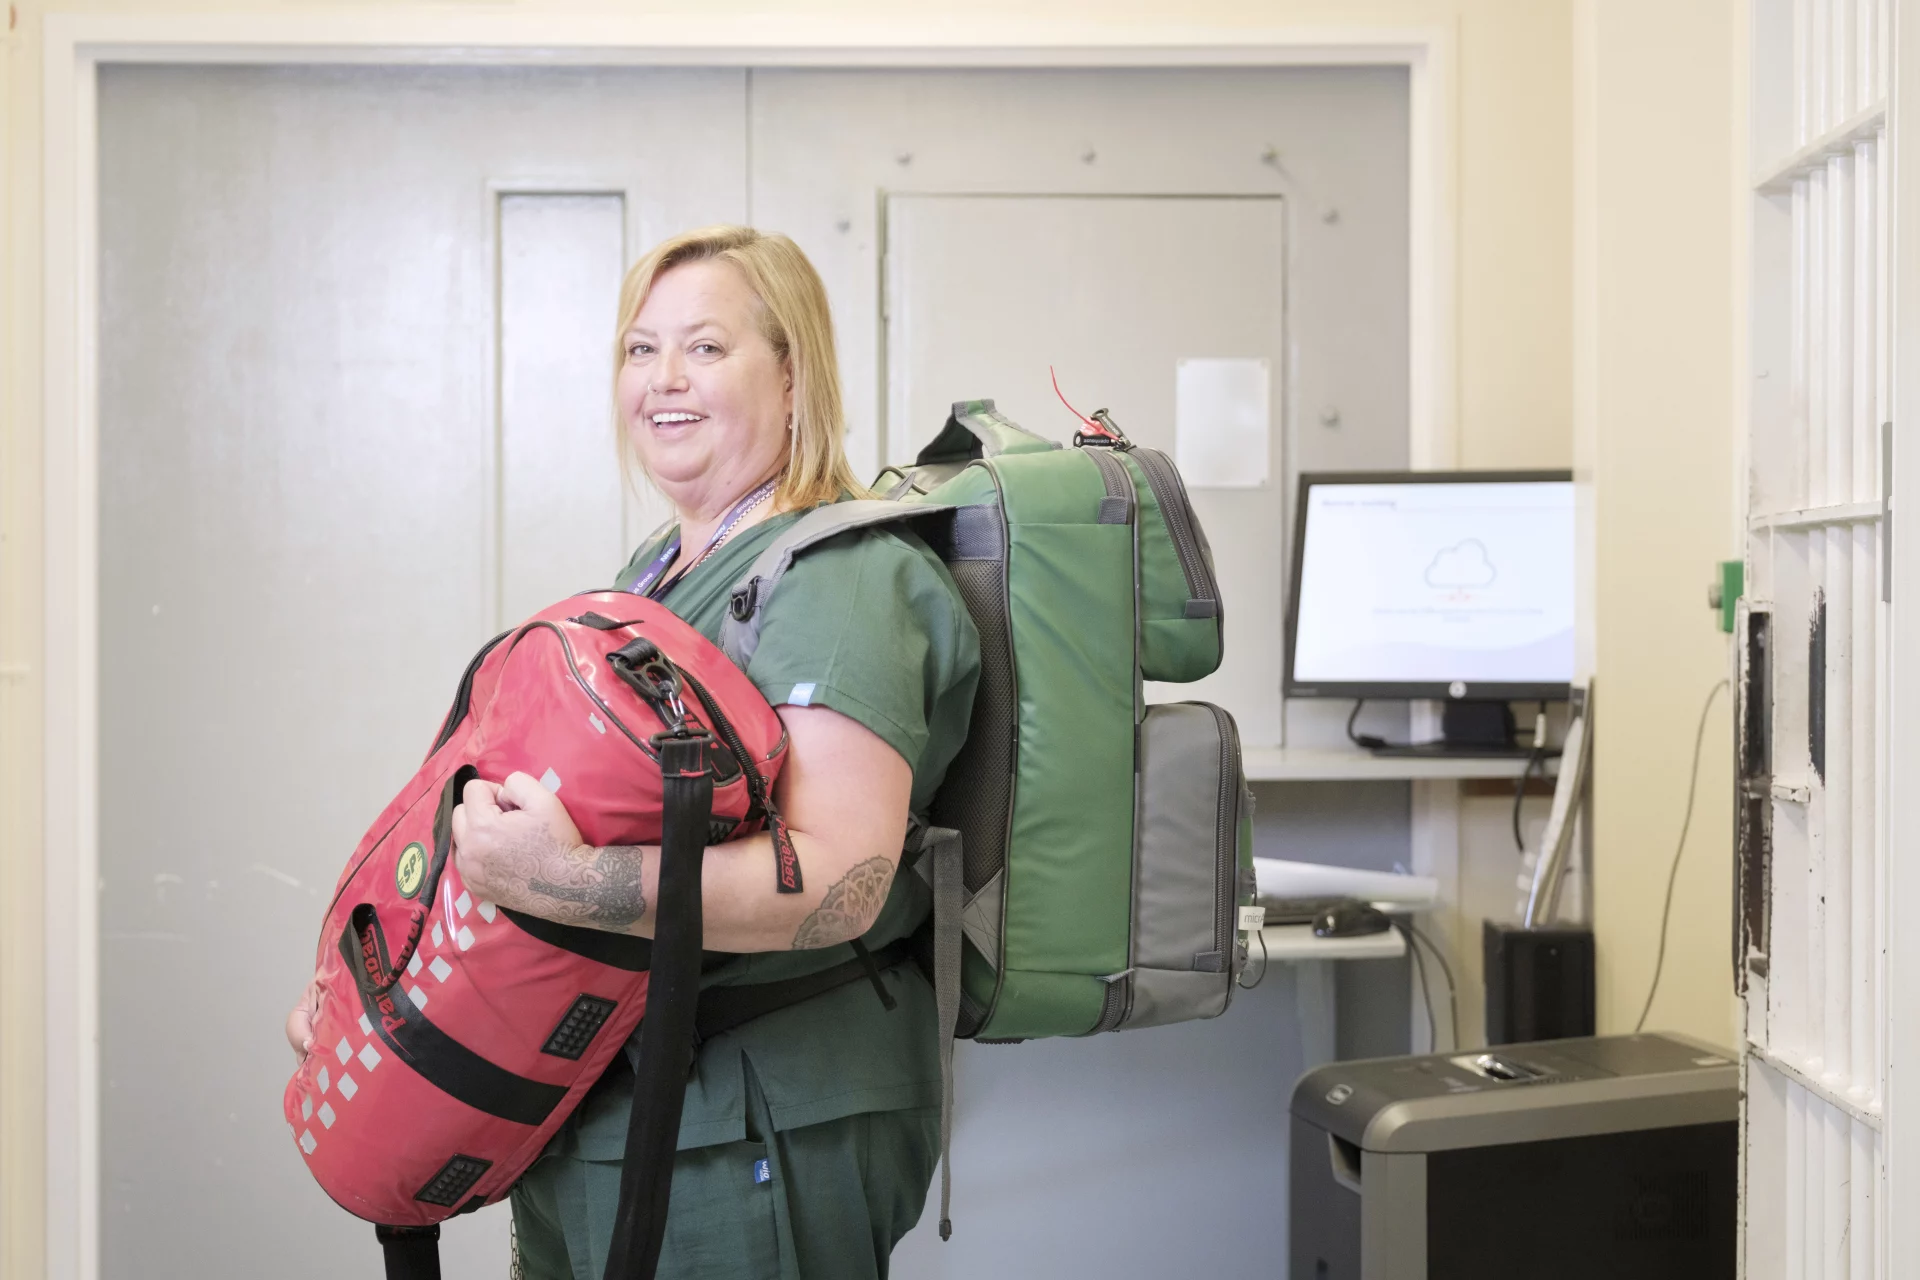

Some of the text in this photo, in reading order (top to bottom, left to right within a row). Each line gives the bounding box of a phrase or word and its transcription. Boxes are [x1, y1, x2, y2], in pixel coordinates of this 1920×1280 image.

[753, 488, 767, 499] Plus
[736, 498, 754, 514] Group
[660, 547, 675, 563] NHS
[637, 572, 653, 588] Group
[775, 817, 796, 888] Parabag
[403, 853, 417, 884] SP
